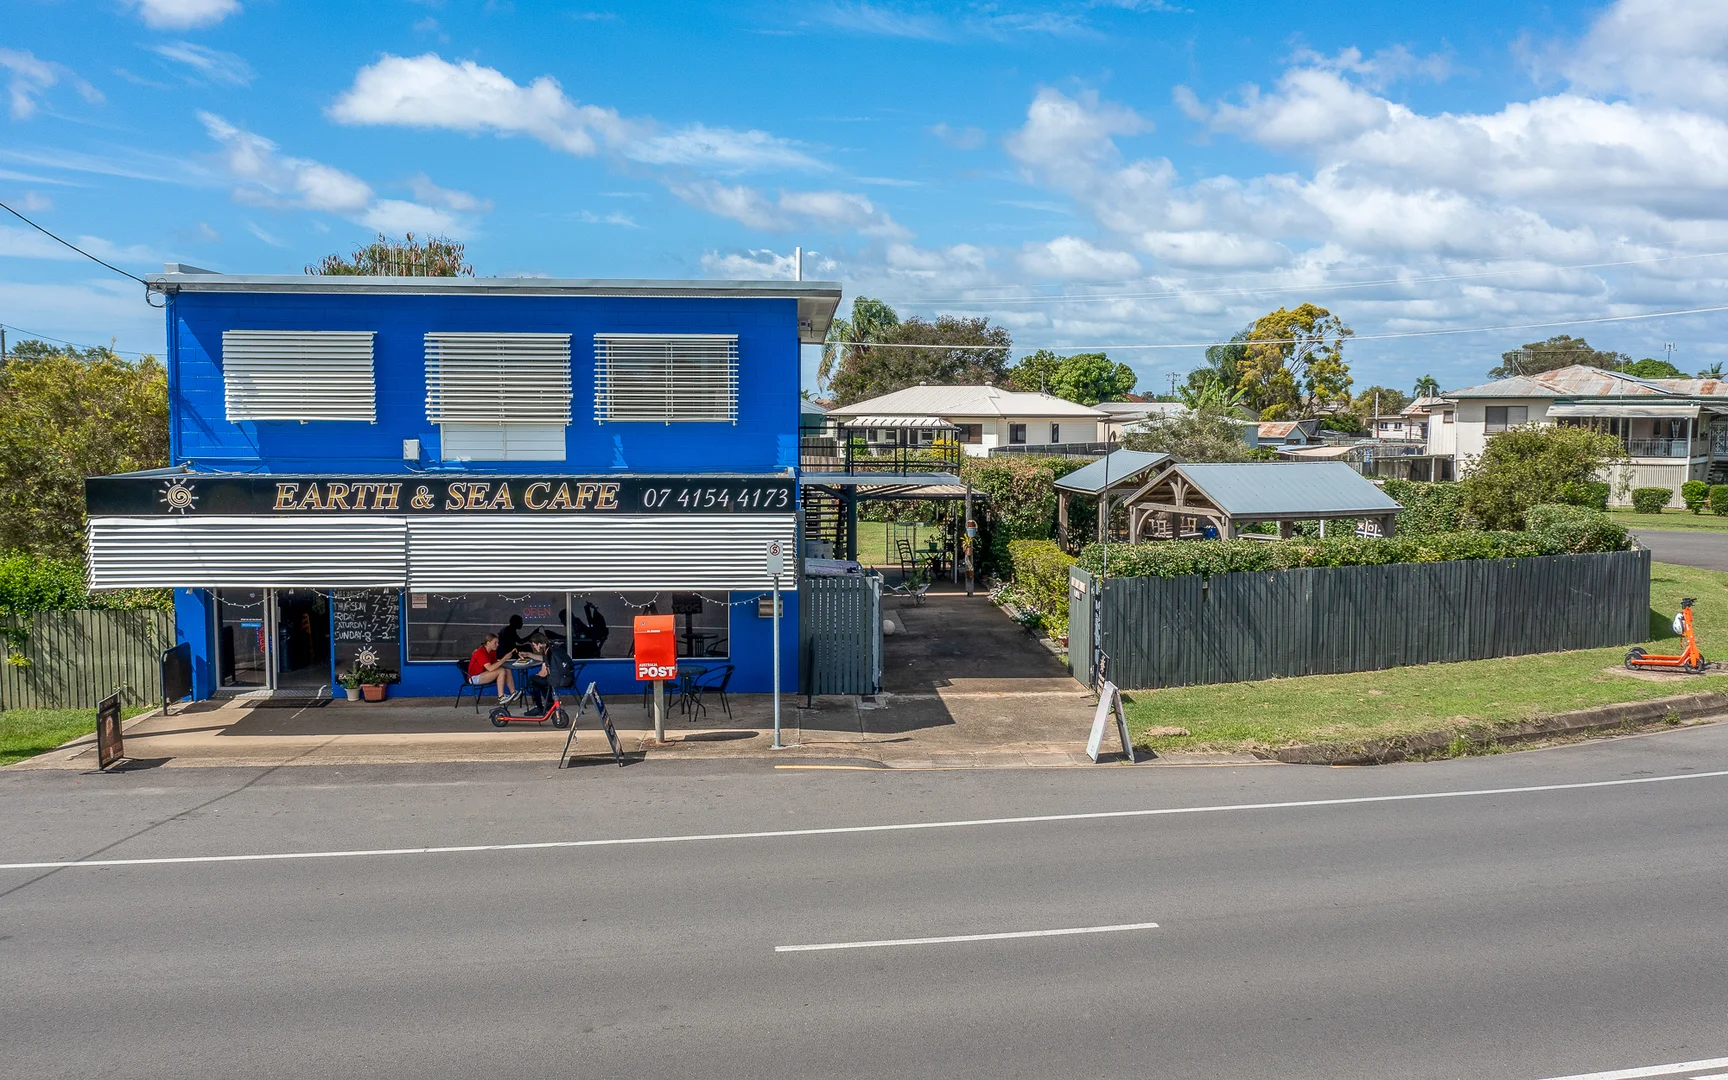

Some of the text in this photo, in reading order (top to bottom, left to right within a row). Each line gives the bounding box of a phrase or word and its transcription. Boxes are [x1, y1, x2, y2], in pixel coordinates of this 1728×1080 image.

[273, 482, 620, 510] EARTH & SEA CAFE
[643, 488, 789, 508] 07 4154 4173
[523, 608, 551, 616] OPEN
[638, 666, 676, 678] POST
